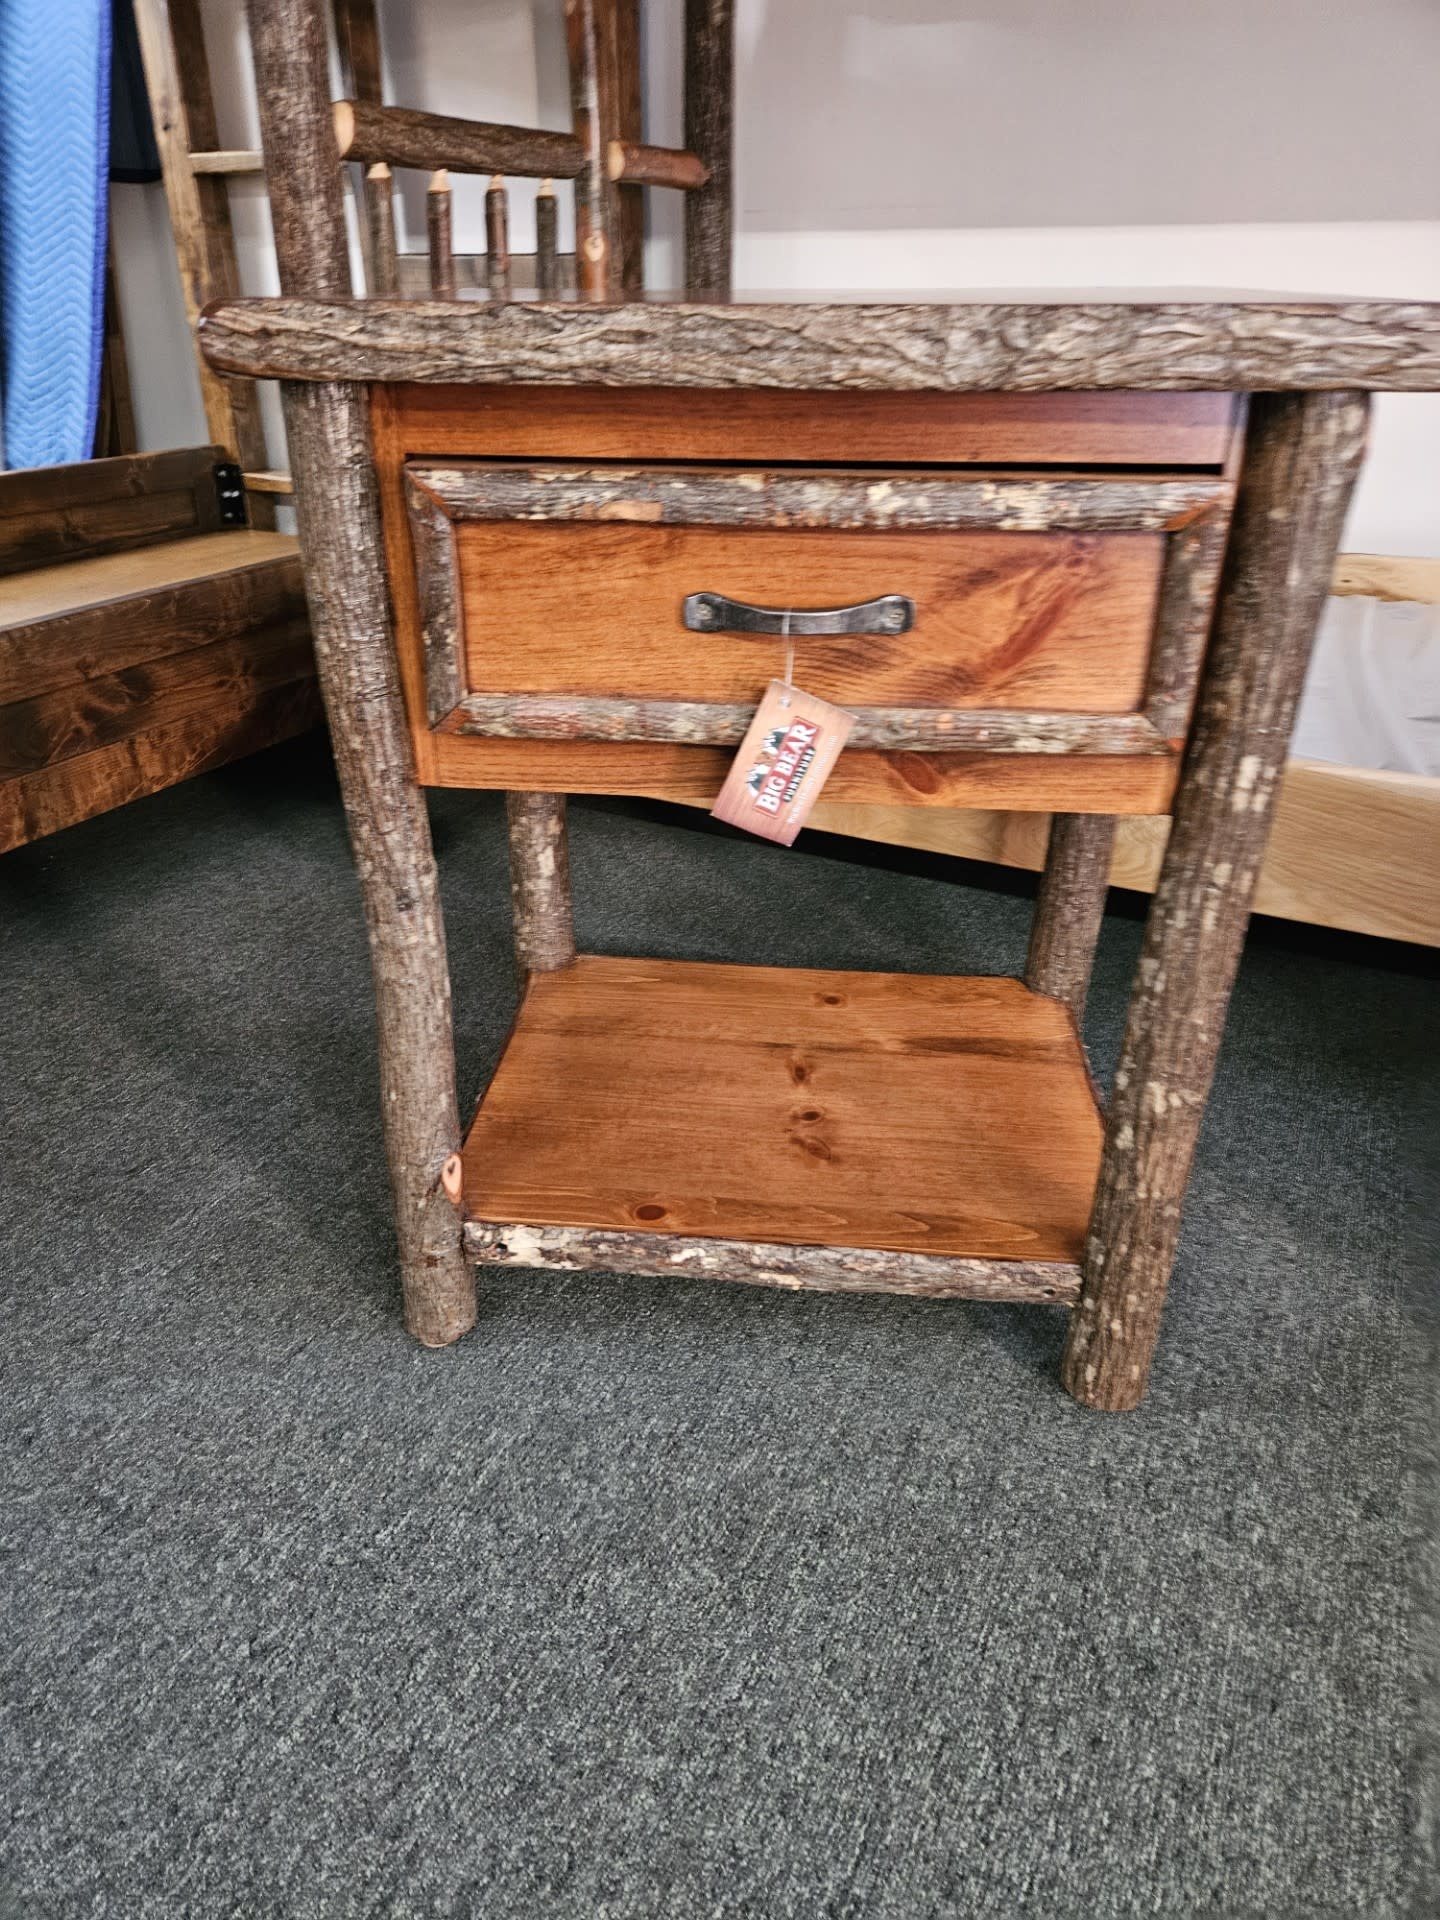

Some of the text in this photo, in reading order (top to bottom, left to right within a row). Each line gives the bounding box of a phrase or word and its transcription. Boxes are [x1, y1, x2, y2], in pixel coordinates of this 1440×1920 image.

[755, 775, 786, 813] BIG
[776, 725, 817, 776] BEAR
[783, 747, 815, 802] FURNITURE
